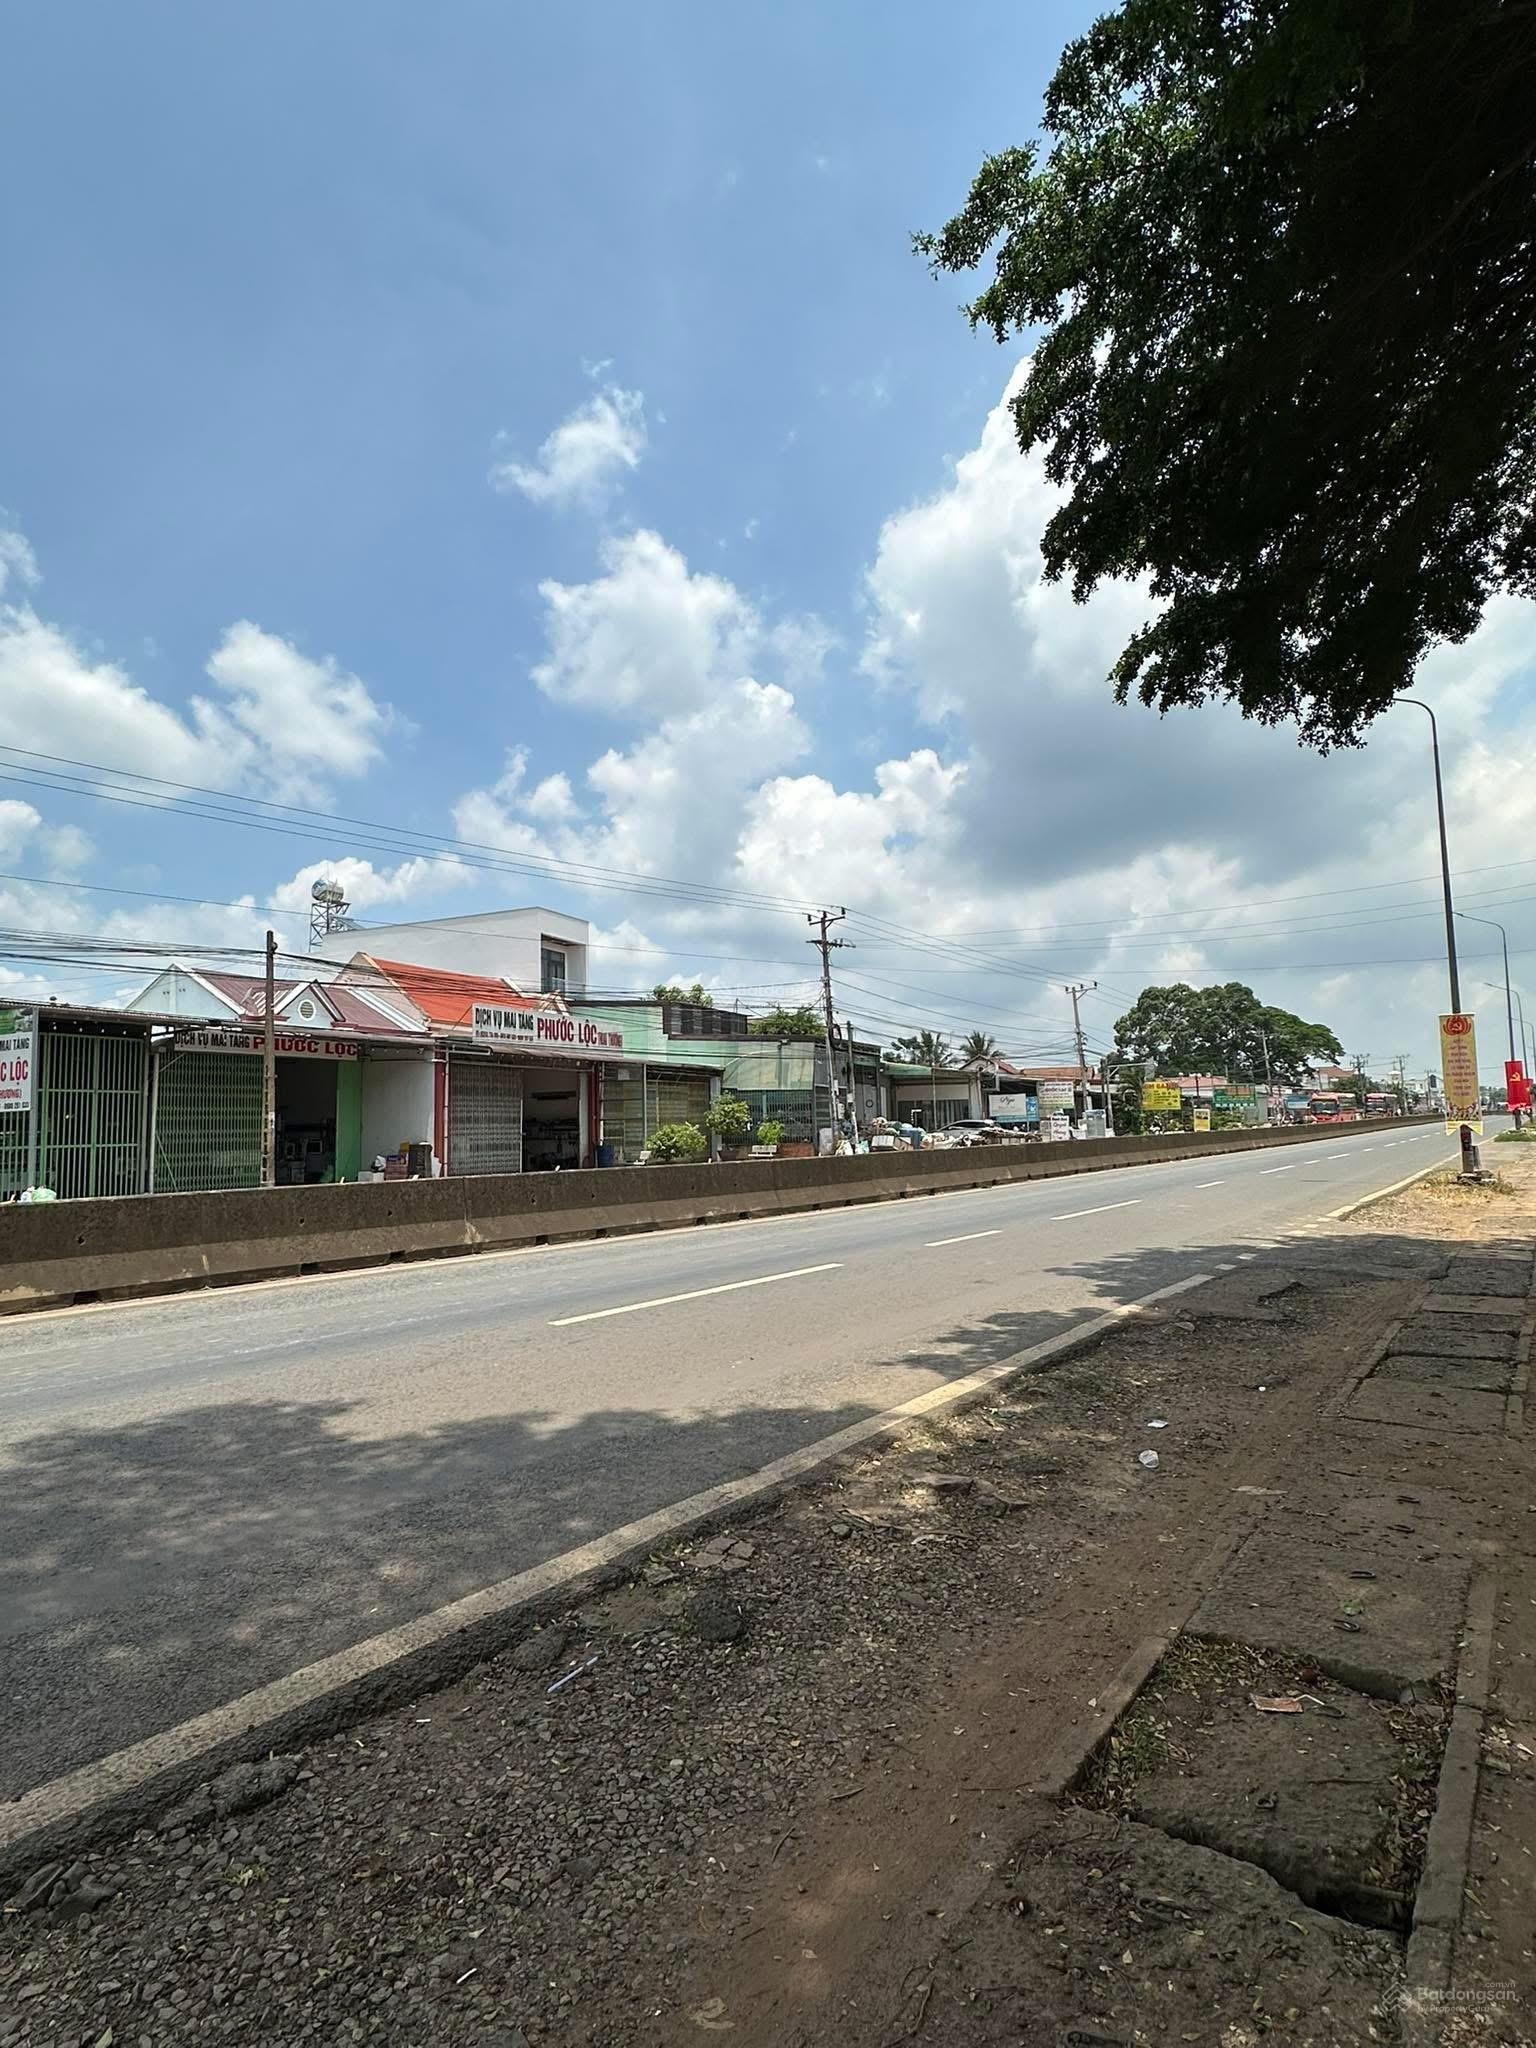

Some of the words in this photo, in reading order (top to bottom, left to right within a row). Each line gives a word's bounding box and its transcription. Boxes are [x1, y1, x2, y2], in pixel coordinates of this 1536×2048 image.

[504, 1011, 517, 1029] MAI
[537, 1016, 574, 1042] PHƯỚC
[578, 1019, 597, 1047] LỘC
[9, 1056, 28, 1085] LỘC
